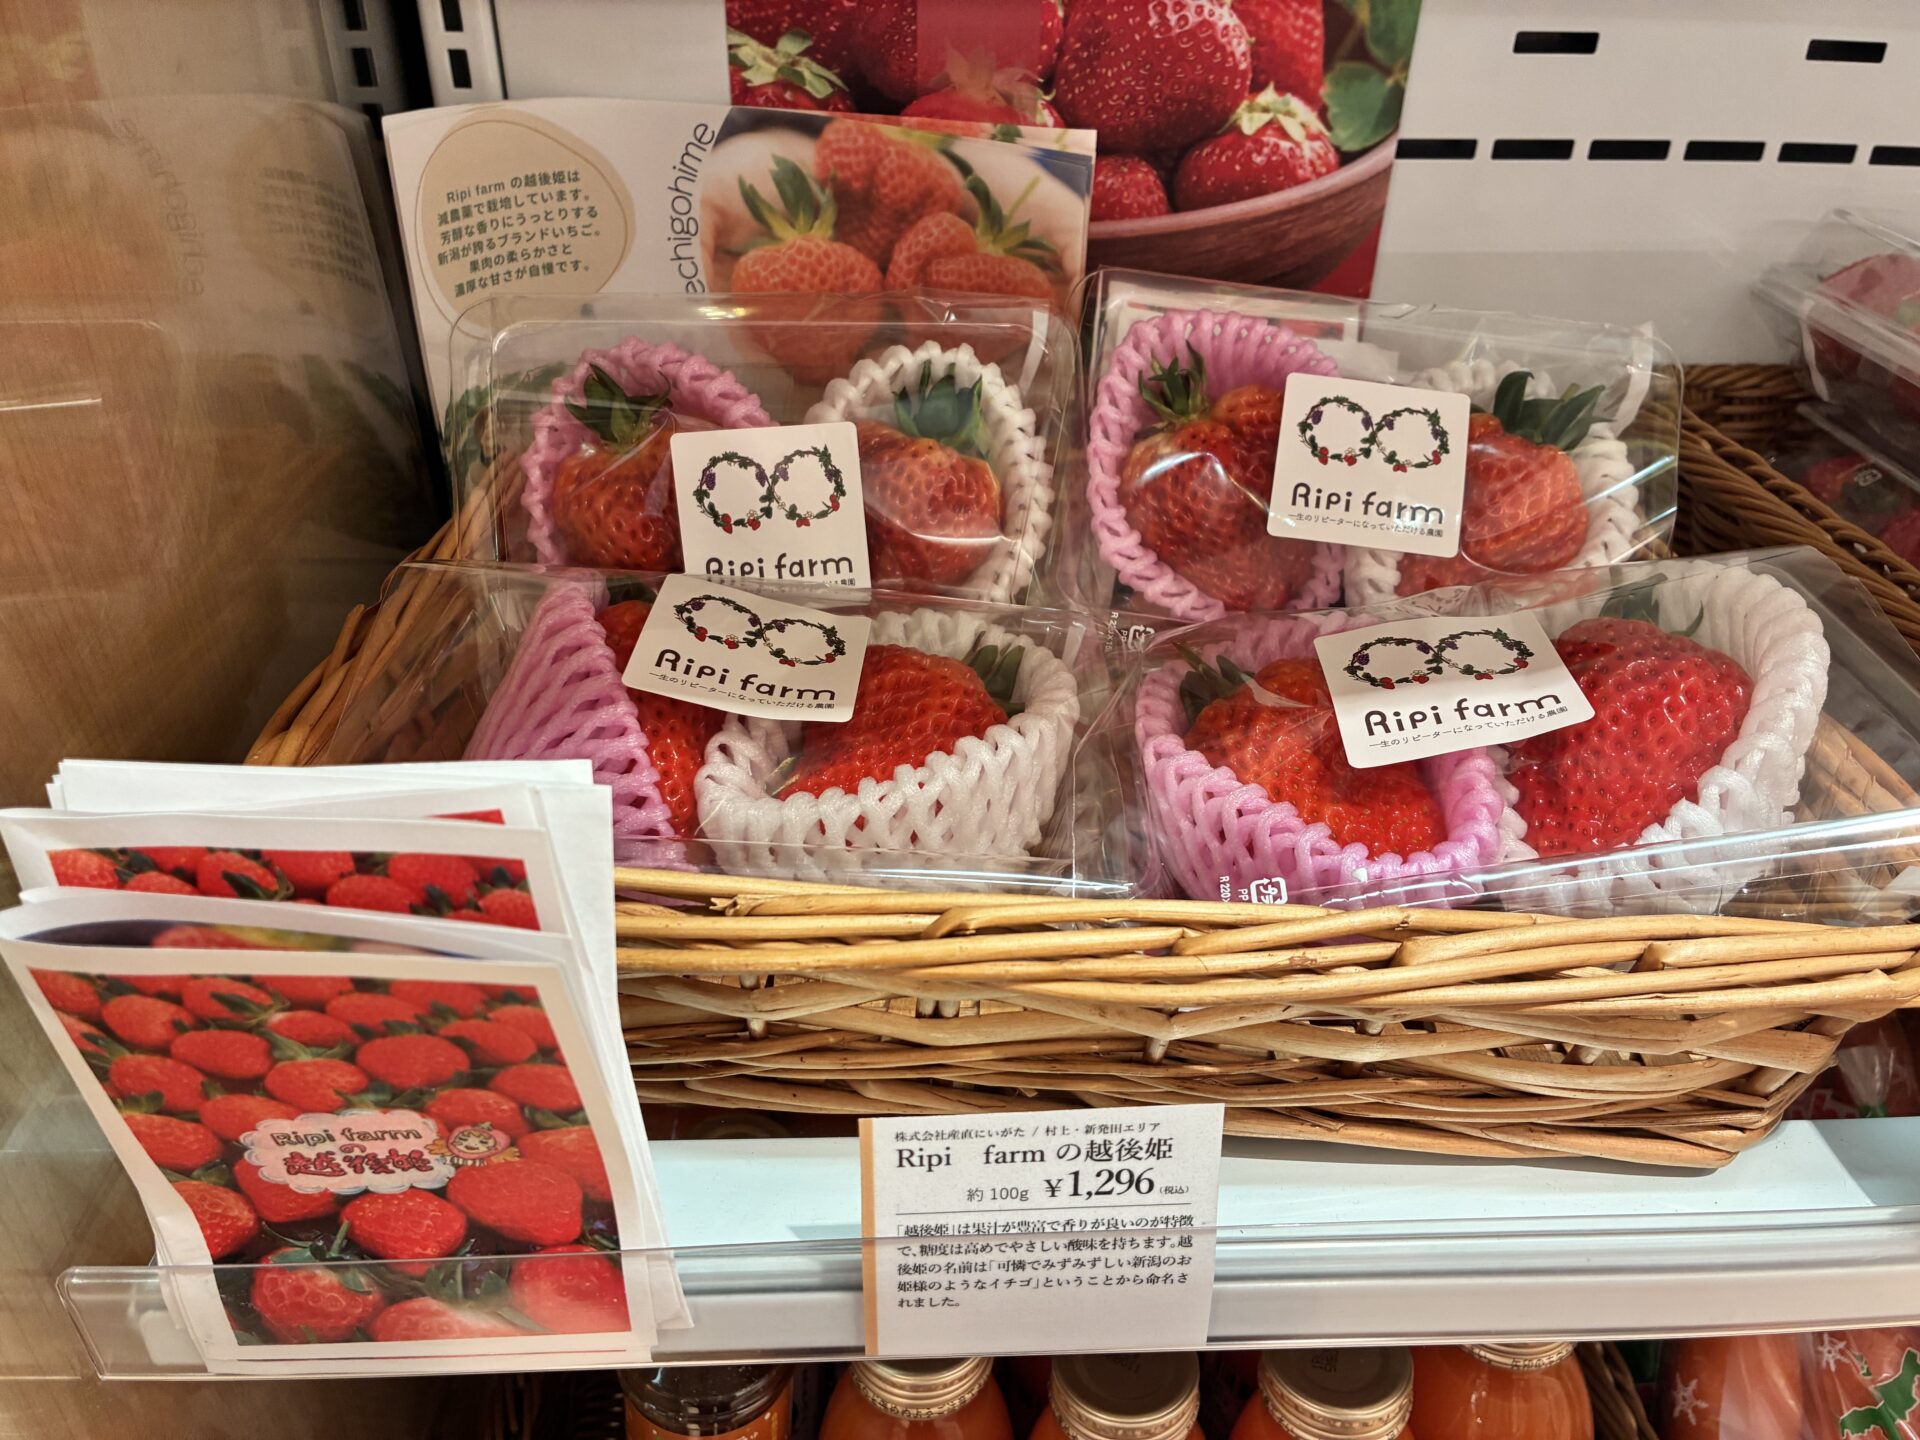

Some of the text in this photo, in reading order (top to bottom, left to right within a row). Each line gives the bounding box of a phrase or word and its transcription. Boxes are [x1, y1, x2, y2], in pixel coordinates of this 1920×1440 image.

[446, 170, 581, 205] Ripi farm の越後姫は
[437, 188, 590, 228] 減農薬で栽培しています。
[440, 205, 599, 247] 芳醇な香りにうっとりする
[437, 224, 601, 267] 新潟が誇るブランドいちご。
[468, 242, 573, 275] 果肉の柔らかさと
[453, 259, 591, 298] 濃厚な甘さが自慢です。
[1291, 482, 1444, 525] Ripi farm
[775, 552, 854, 579] farm
[654, 648, 837, 702] Ripi farm
[1364, 694, 1562, 737] Ripi farm
[1238, 888, 1249, 901] PP
[270, 1127, 422, 1147] Ripi farm
[339, 1143, 366, 1153] の
[894, 1126, 1026, 1143] 株式会社産直にいがた
[1045, 1121, 1161, 1138] 村上・新発田エリア
[284, 1148, 434, 1177] 越後姫
[896, 1137, 1175, 1173] Ripi farm の越後姫
[990, 1187, 1030, 1202] 100g
[1043, 1167, 1155, 1201] ¥1,296
[896, 1235, 1194, 1257] で、糖度は高めでやさしい酸味を持ちます。越
[896, 1255, 1193, 1276] 後姫の名前は「可憐でみずみずしい新潟のお
[896, 1272, 1189, 1293] 姫様のようなイチゴ」ということから命名さ
[897, 1296, 960, 1309] れました。
